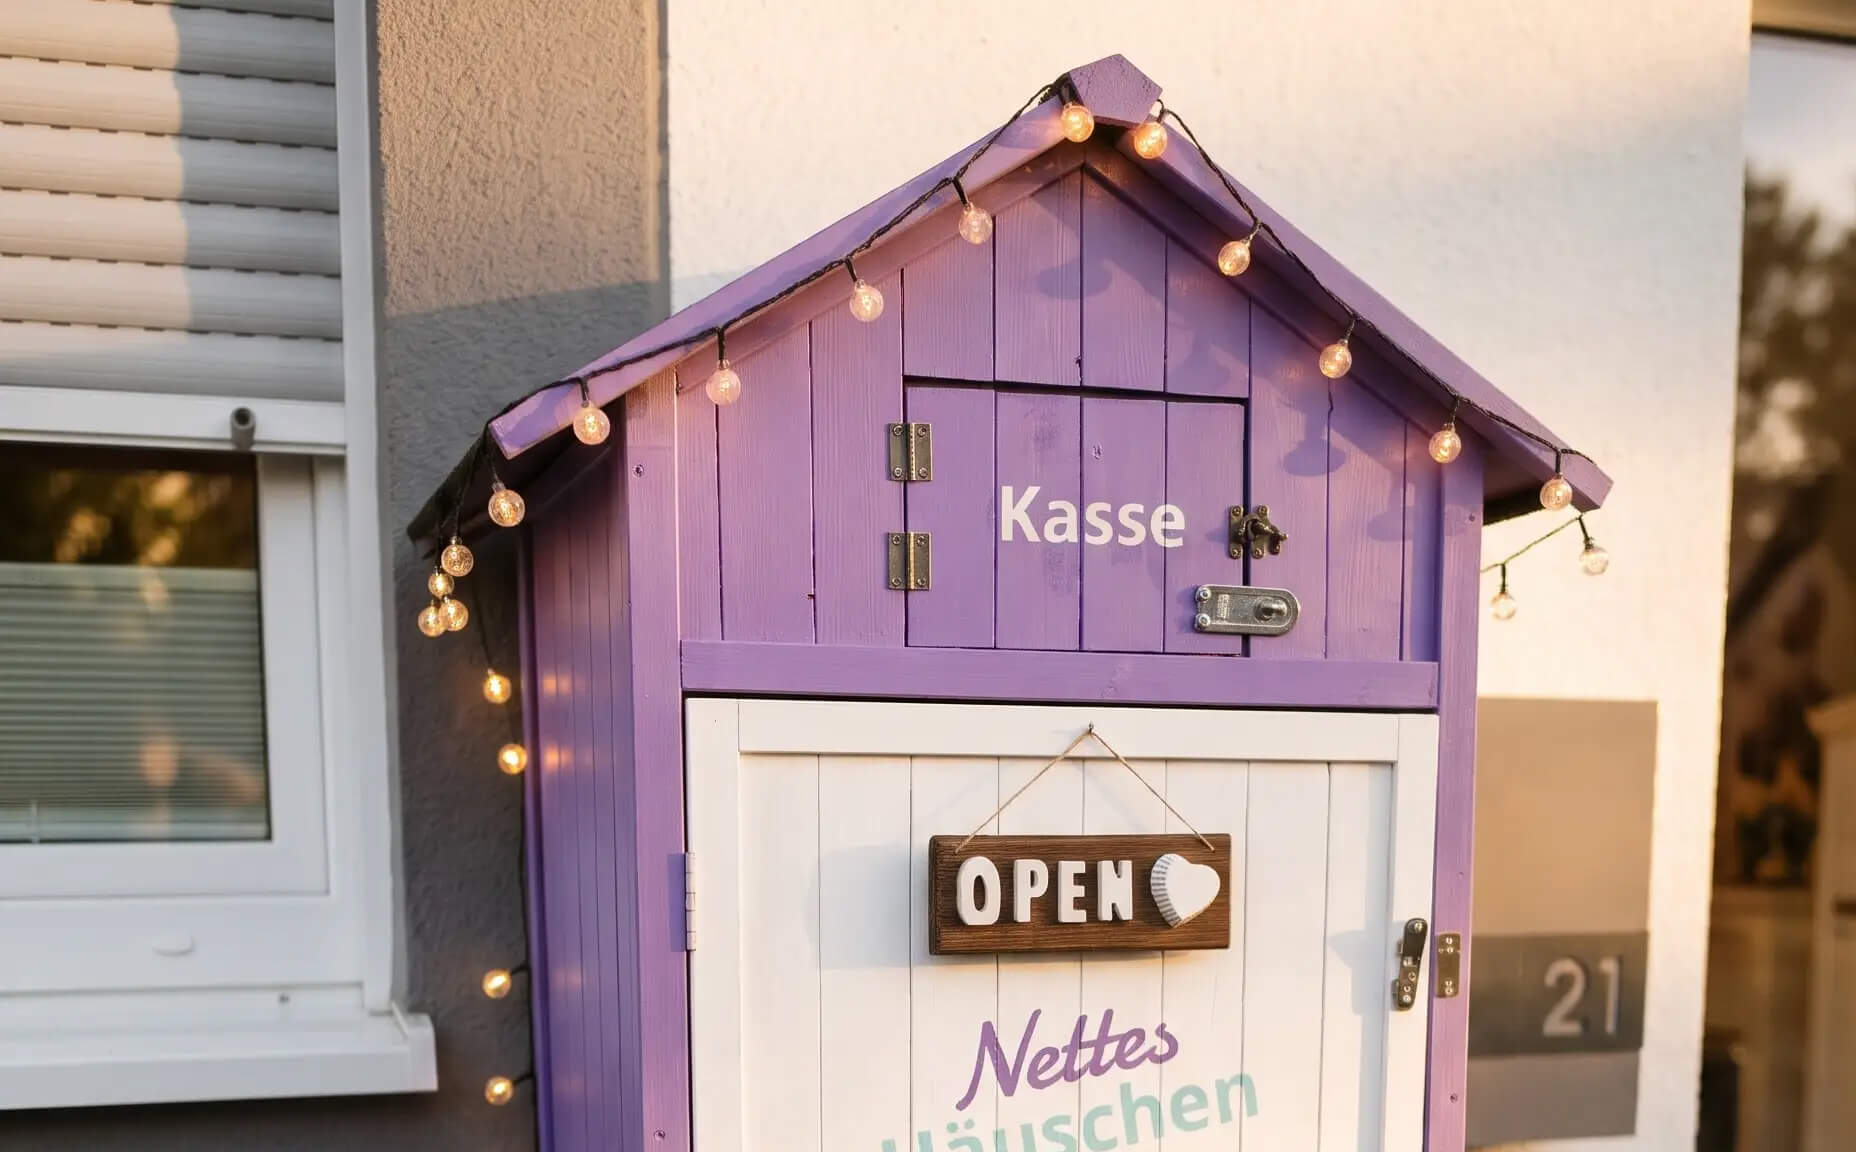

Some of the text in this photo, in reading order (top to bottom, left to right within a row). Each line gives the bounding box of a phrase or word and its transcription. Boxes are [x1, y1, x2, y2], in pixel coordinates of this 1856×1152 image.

[1000, 485, 1186, 548] Kasse
[956, 856, 1133, 926] OPEN
[1541, 956, 1621, 1038] 21
[955, 1008, 1179, 1112] Nettes
